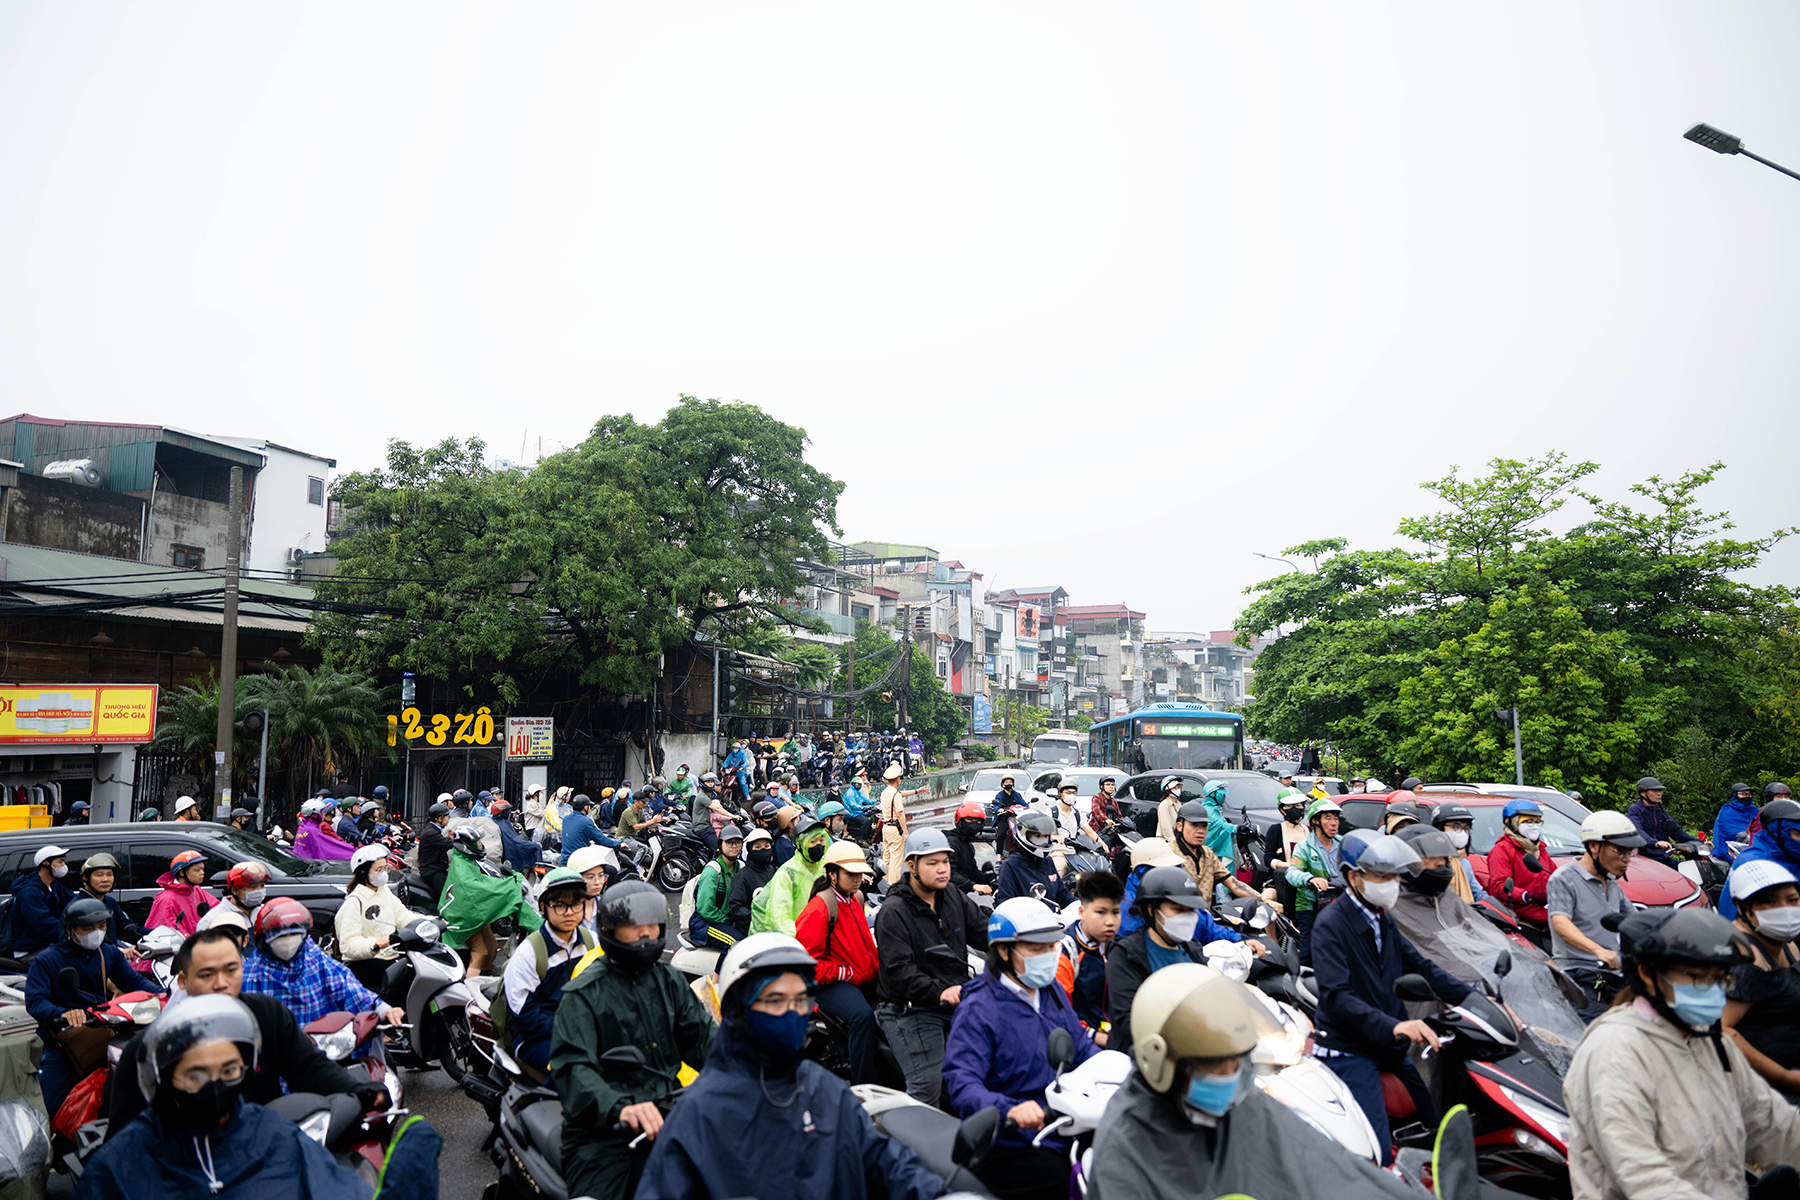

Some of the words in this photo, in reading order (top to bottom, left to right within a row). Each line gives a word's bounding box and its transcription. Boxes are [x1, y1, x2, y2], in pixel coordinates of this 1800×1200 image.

[103, 709, 129, 719] QUỐC
[453, 706, 495, 745] ZÔ
[1144, 724, 1157, 735] 54
[1161, 726, 1178, 735] LONG
[510, 727, 529, 755] LẨU
